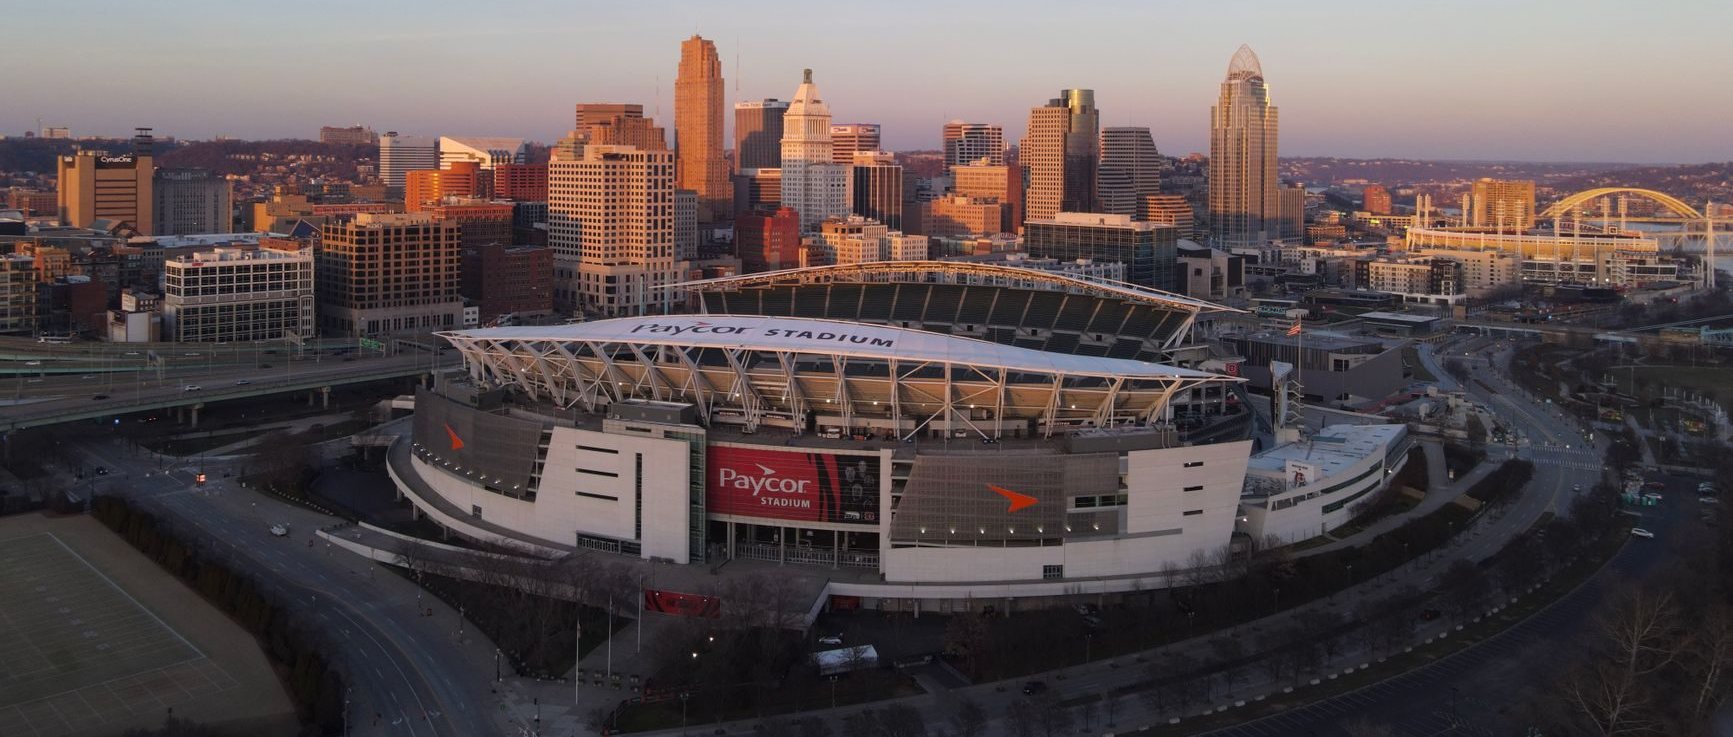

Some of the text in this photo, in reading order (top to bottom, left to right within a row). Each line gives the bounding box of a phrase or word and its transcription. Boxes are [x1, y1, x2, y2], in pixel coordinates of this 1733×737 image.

[631, 323, 894, 348] Paycor STADIUM
[720, 468, 811, 496] Paycor
[761, 497, 810, 508] STADIUM
